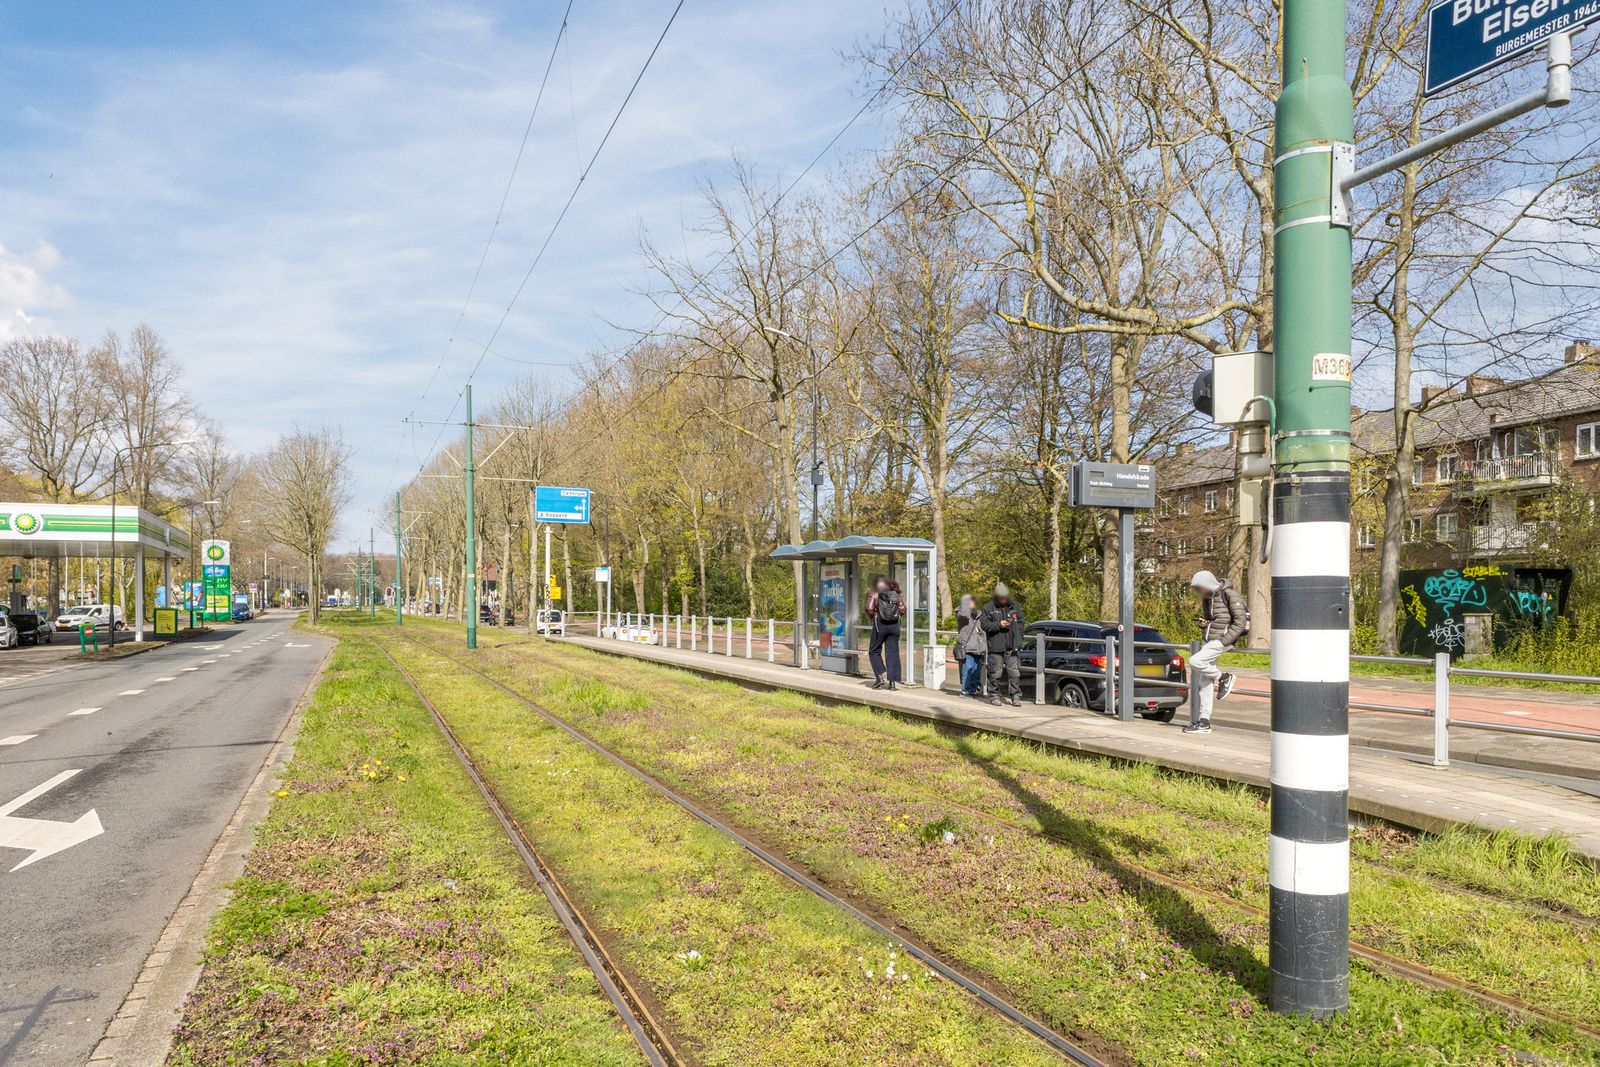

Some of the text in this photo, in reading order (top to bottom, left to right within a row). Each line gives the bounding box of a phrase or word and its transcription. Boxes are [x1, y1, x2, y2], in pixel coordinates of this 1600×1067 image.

[1453, 0, 1518, 26] Bu
[1496, 14, 1569, 57] BURGEMEESTER
[1116, 472, 1150, 481] Handelskade
